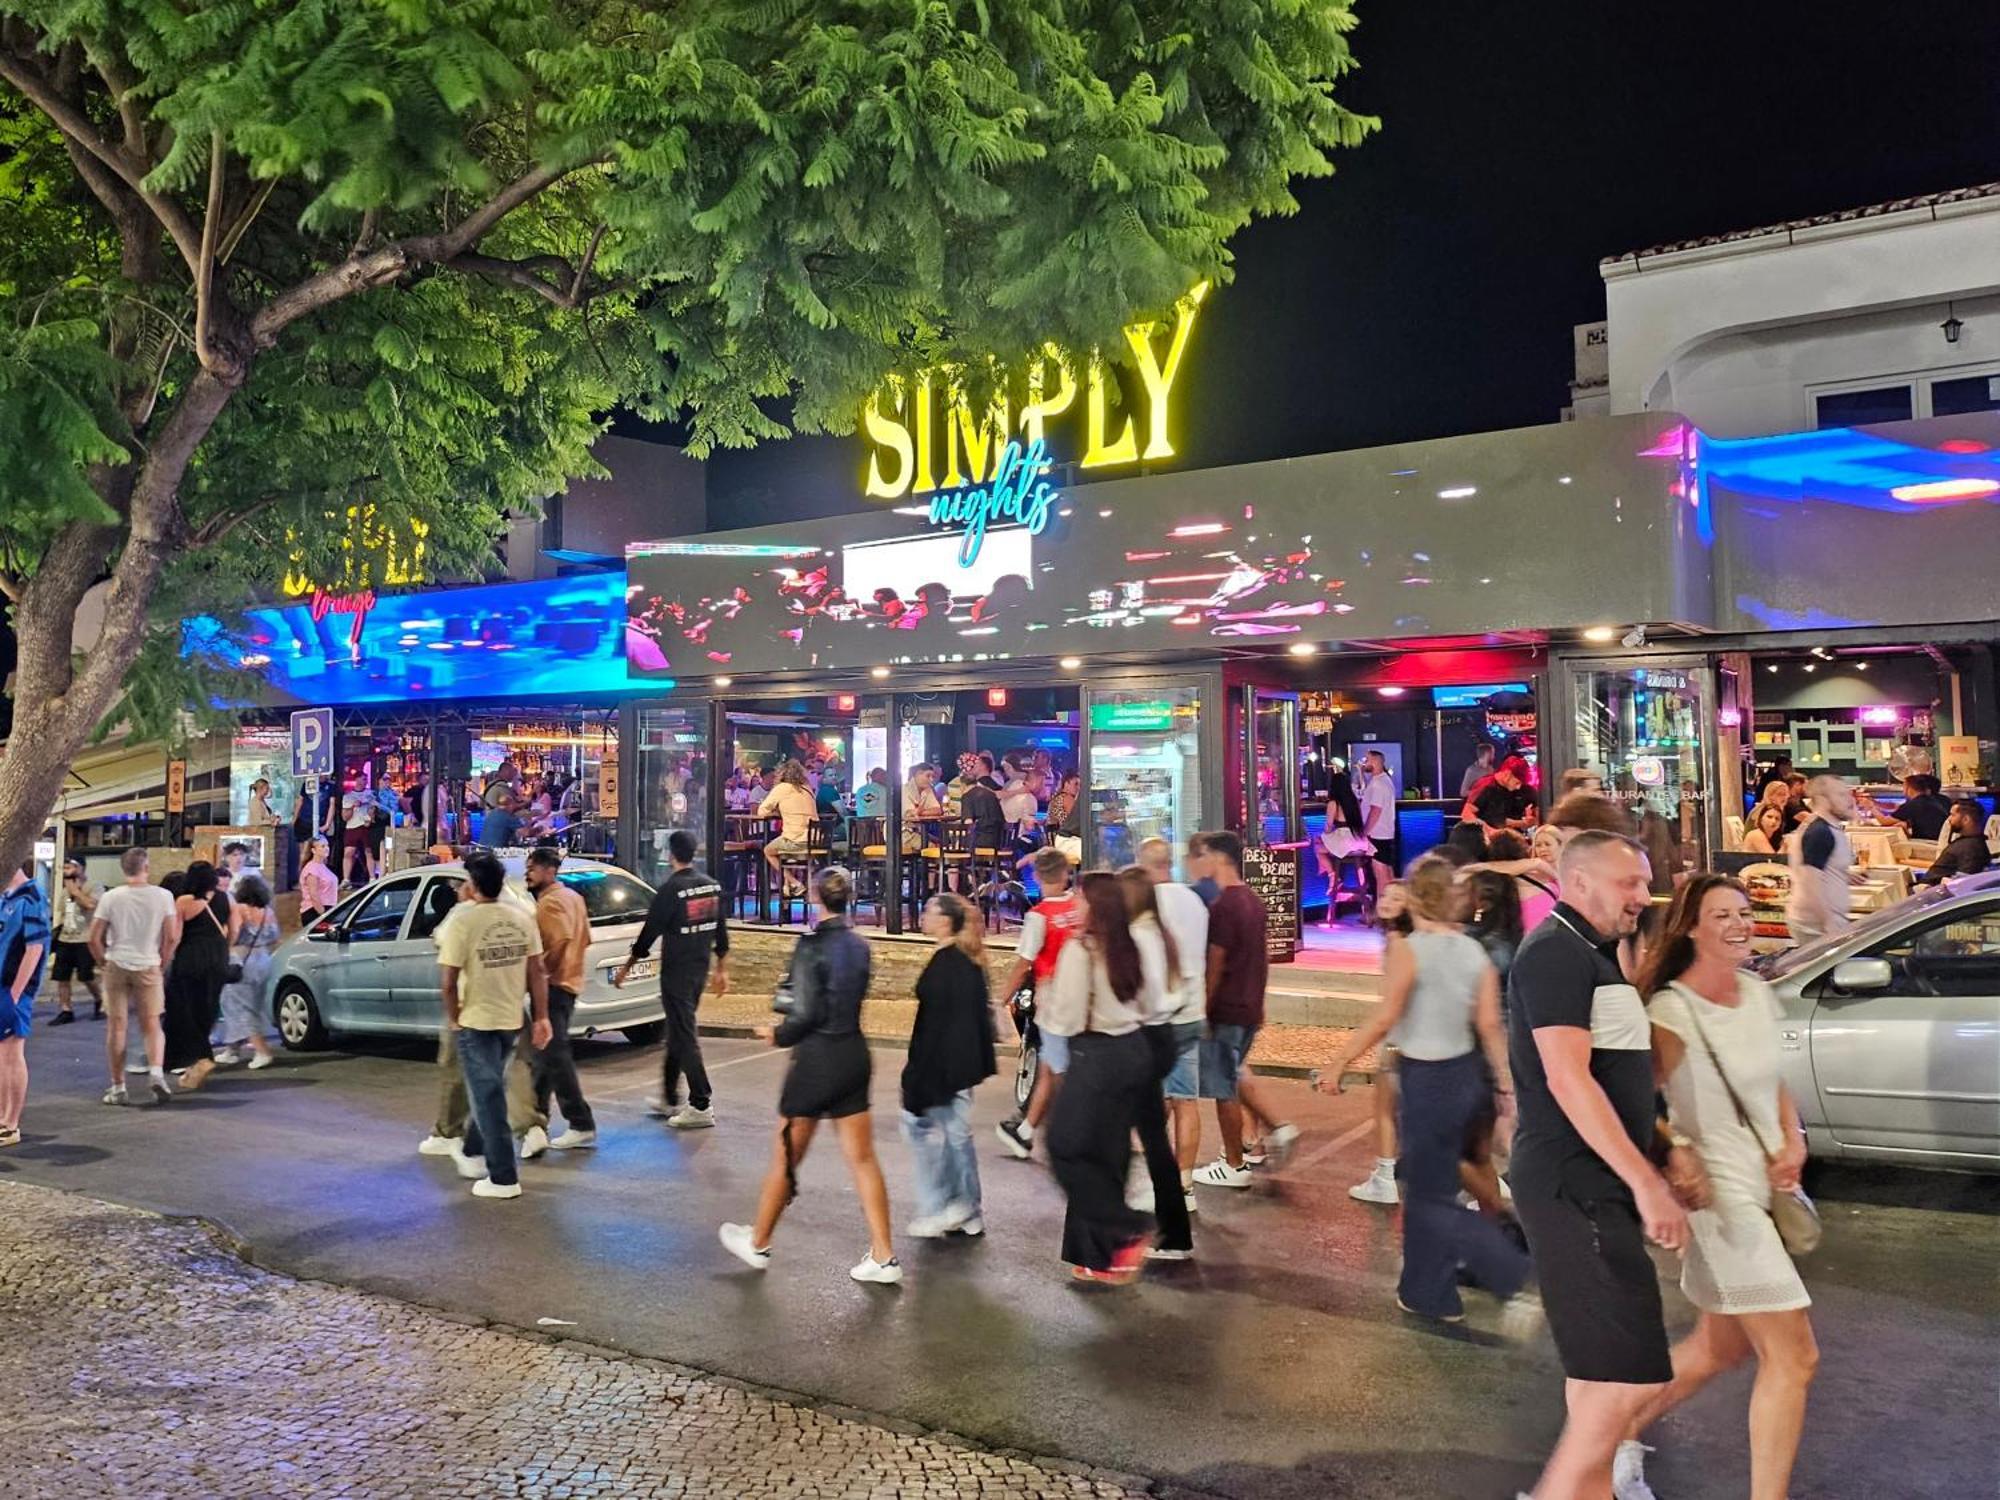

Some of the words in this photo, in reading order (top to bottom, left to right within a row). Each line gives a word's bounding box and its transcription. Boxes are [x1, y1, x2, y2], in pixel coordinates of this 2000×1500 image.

[865, 280, 1208, 498] SIMPLY
[929, 438, 1058, 569] nights
[299, 717, 322, 770] P
[1245, 848, 1278, 862] BEST
[1945, 924, 1983, 941] HOME
